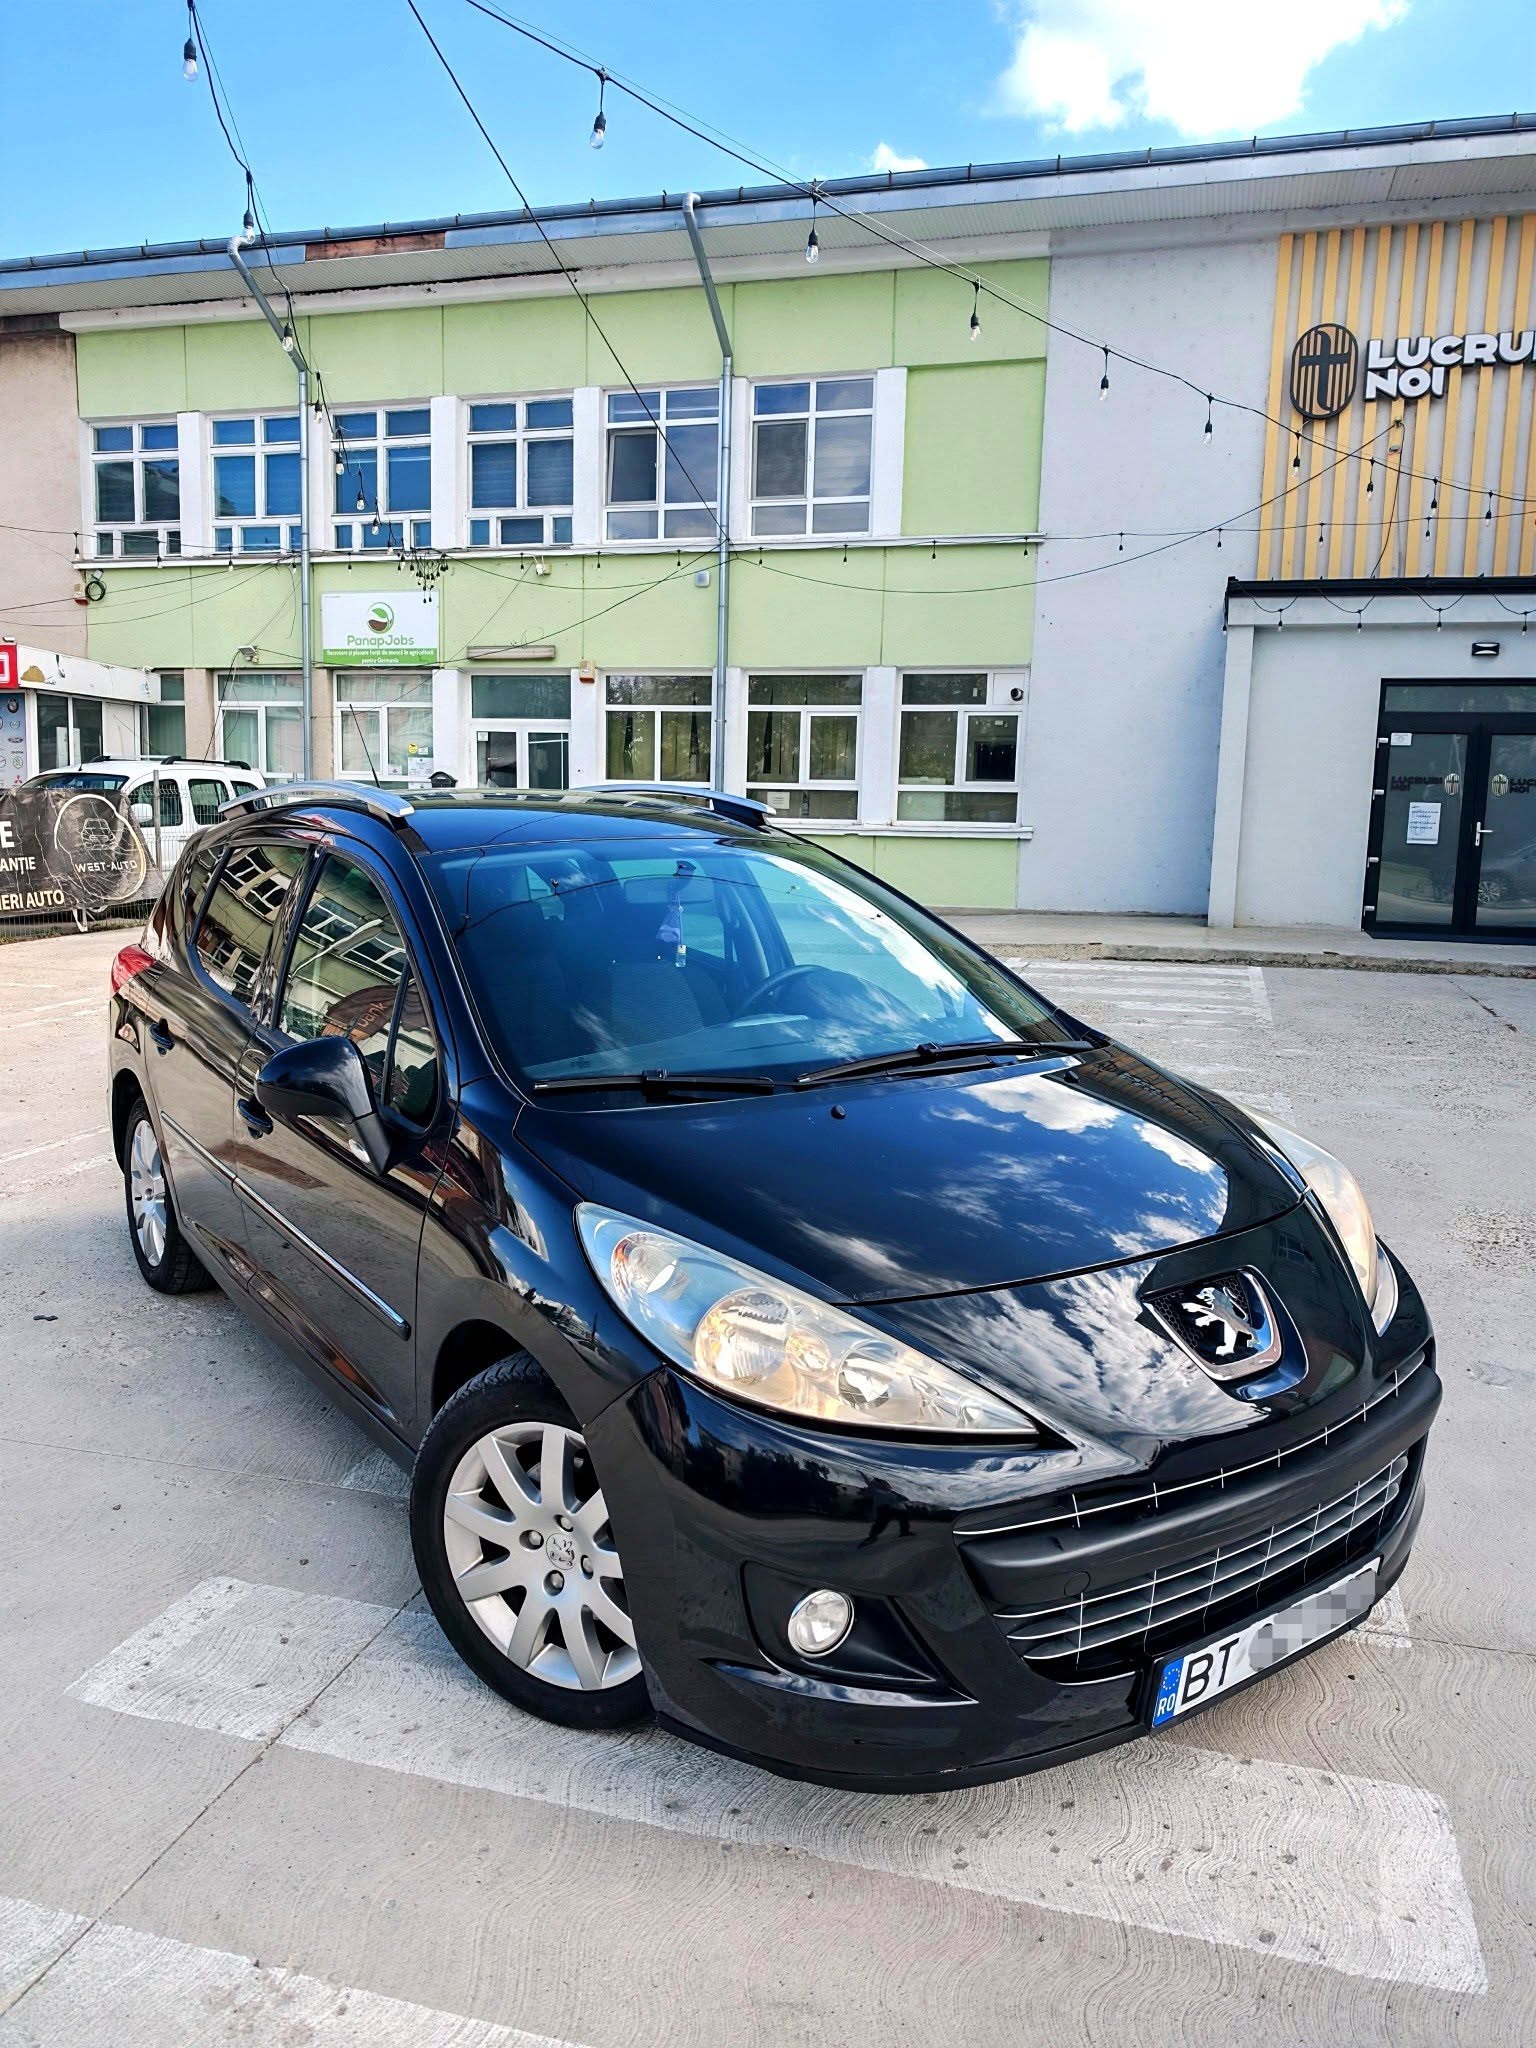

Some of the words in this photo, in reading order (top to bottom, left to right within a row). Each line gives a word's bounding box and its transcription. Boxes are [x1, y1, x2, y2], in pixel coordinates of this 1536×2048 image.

[1367, 330, 1536, 369] LUCRU
[1365, 366, 1445, 400] NOI
[347, 634, 414, 648] PanapJobs
[75, 860, 138, 873] WEST-AUTO
[26, 890, 65, 908] AUTO
[1180, 1637, 1240, 1707] BT
[1157, 1692, 1176, 1718] RO
